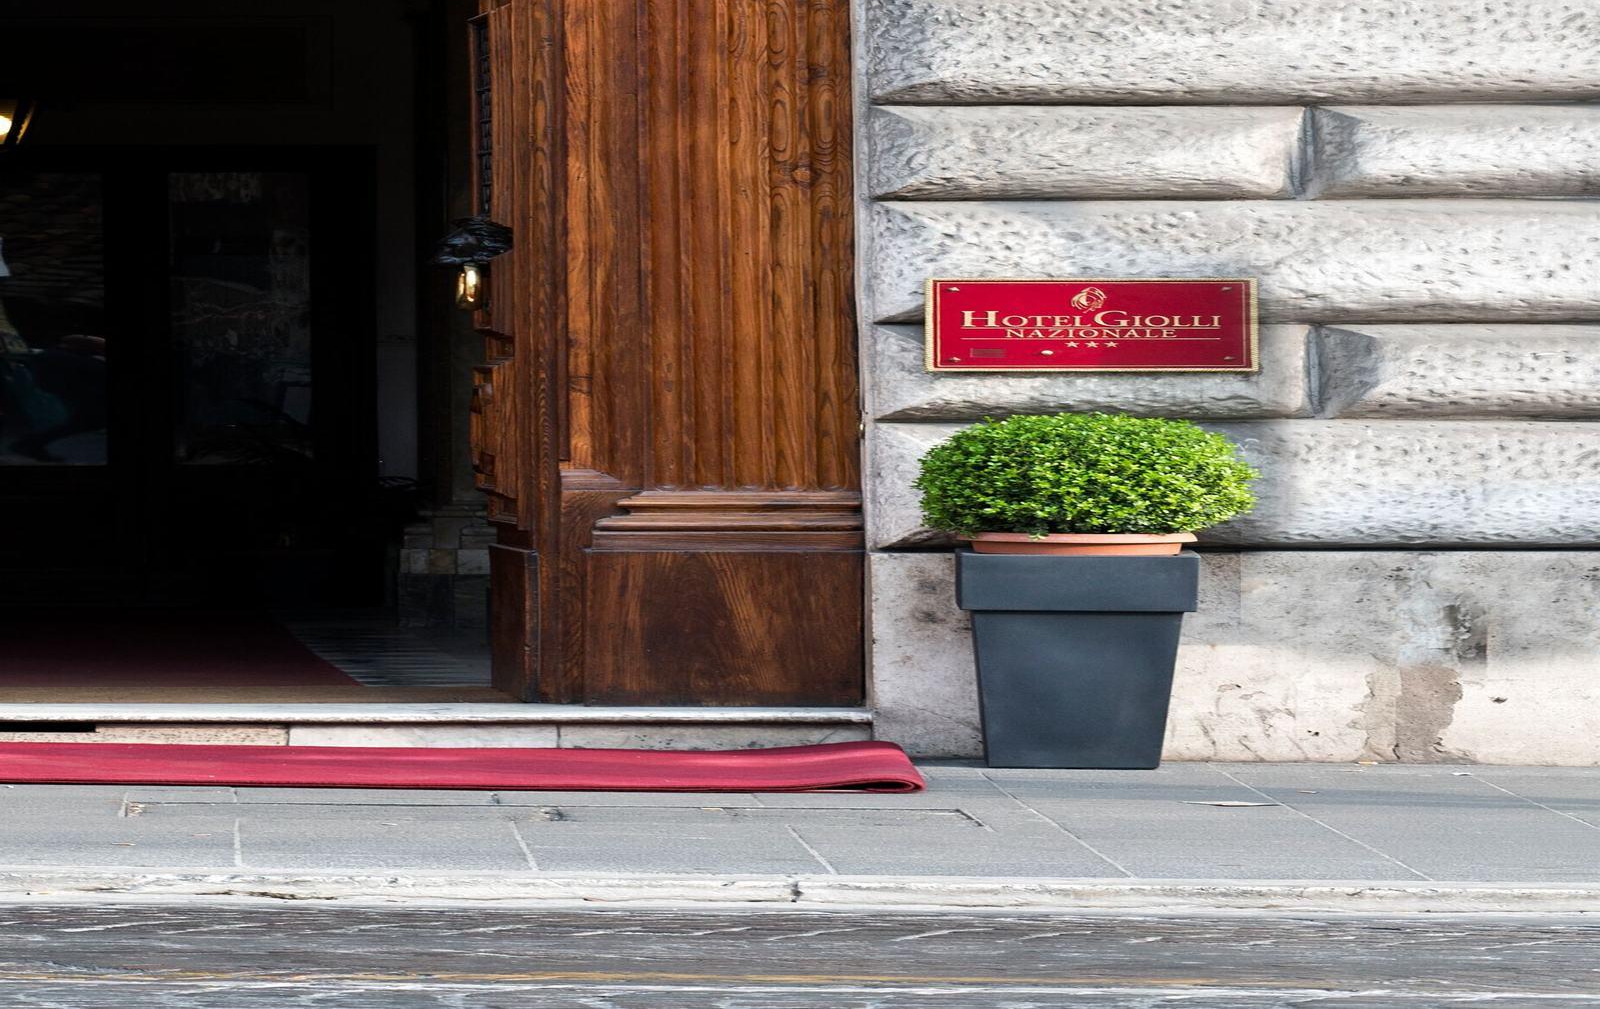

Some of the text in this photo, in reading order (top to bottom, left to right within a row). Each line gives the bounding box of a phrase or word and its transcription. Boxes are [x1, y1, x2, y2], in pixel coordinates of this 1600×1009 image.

[961, 309, 1221, 328] HOTEL GIOLLI
[1005, 327, 1177, 339] NAZIONALE
